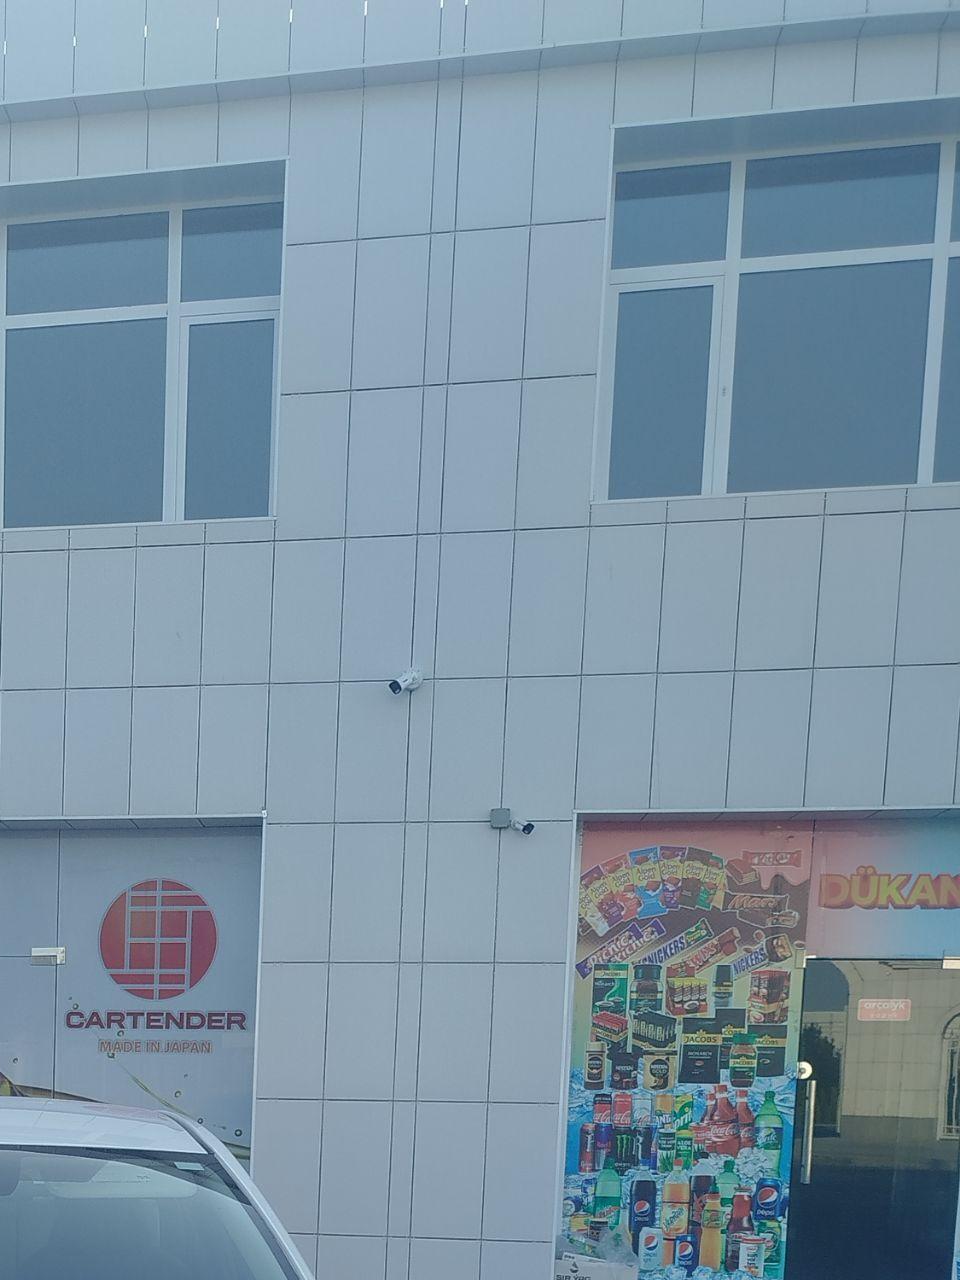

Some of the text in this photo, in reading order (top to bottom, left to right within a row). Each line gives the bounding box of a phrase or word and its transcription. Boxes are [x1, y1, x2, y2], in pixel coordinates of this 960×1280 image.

[733, 947, 766, 976] NICKERS
[66, 1011, 247, 1031] CARTENDER
[684, 1035, 718, 1044] JACOBS
[99, 1040, 213, 1054] MADE IN JAPAN
[756, 1208, 776, 1217] pepsi
